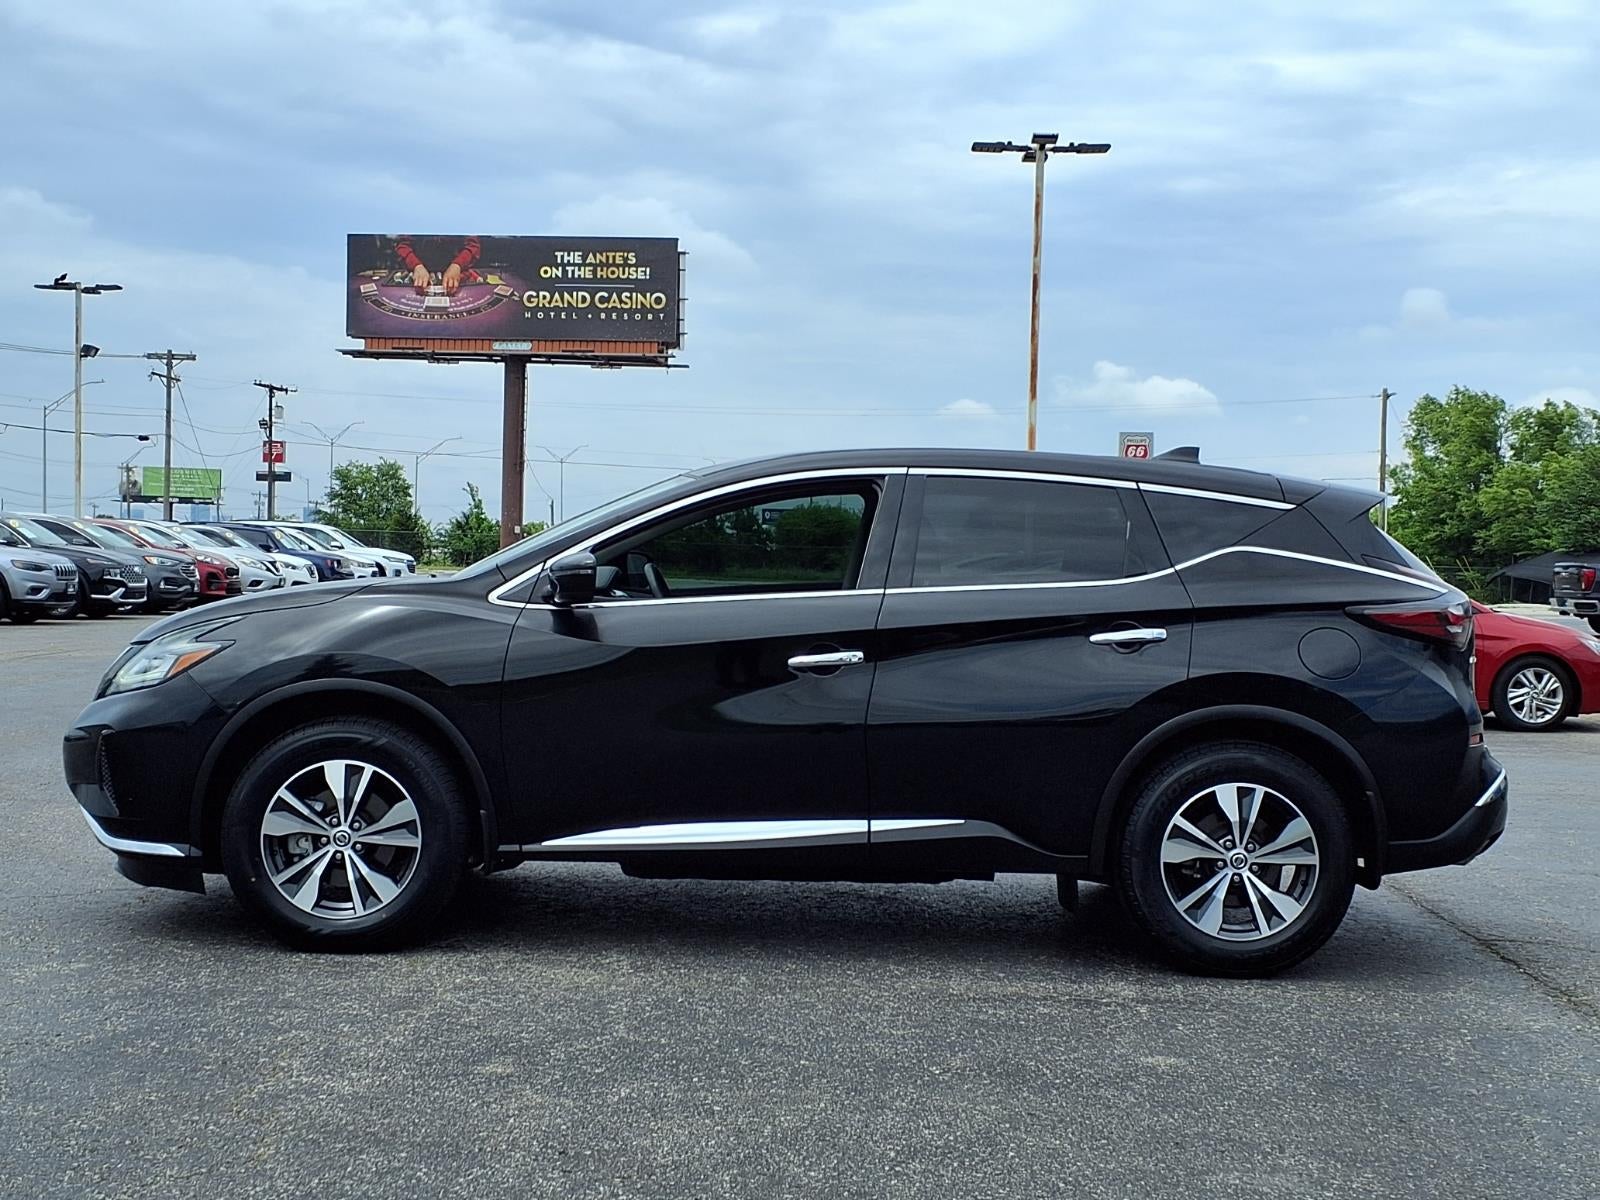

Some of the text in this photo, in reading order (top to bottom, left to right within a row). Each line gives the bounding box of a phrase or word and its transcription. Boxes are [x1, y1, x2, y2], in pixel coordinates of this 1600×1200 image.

[555, 251, 636, 264] THE ANTE'S
[539, 266, 650, 280] ON THE HOUSE!
[523, 290, 667, 309] GRAND CASINO
[525, 311, 665, 321] HOTEL RESORT
[1127, 446, 1146, 457] 66
